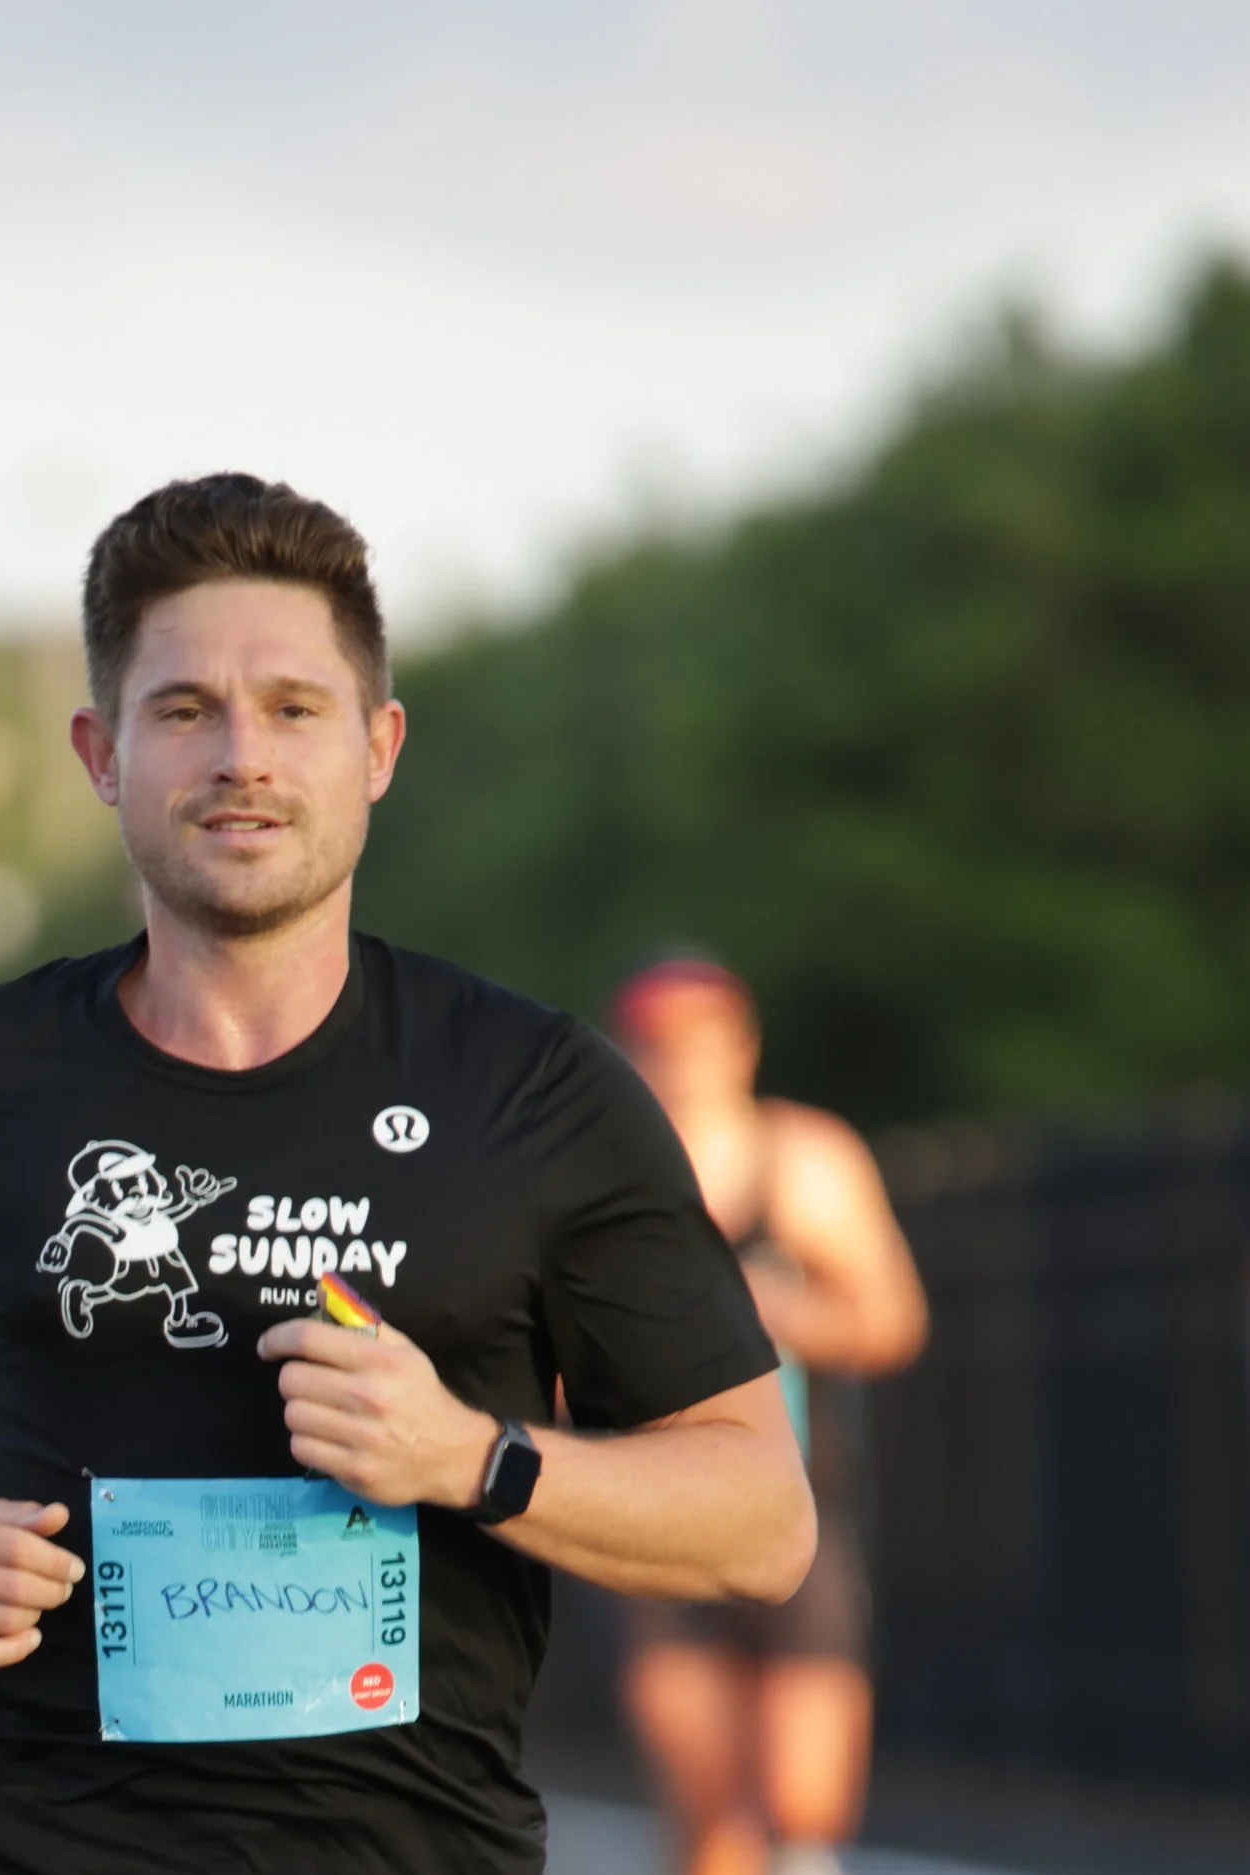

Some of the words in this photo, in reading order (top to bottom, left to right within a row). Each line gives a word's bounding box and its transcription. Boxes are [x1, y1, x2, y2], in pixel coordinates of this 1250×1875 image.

[246, 1195, 370, 1235] SLOW
[209, 1233, 407, 1287] SUNDAY
[260, 1287, 299, 1306] RUN
[98, 1561, 127, 1659] 13119
[161, 1577, 368, 1620] BRANDON
[381, 1551, 407, 1648] 13119
[224, 1691, 294, 1709] MARATHON
